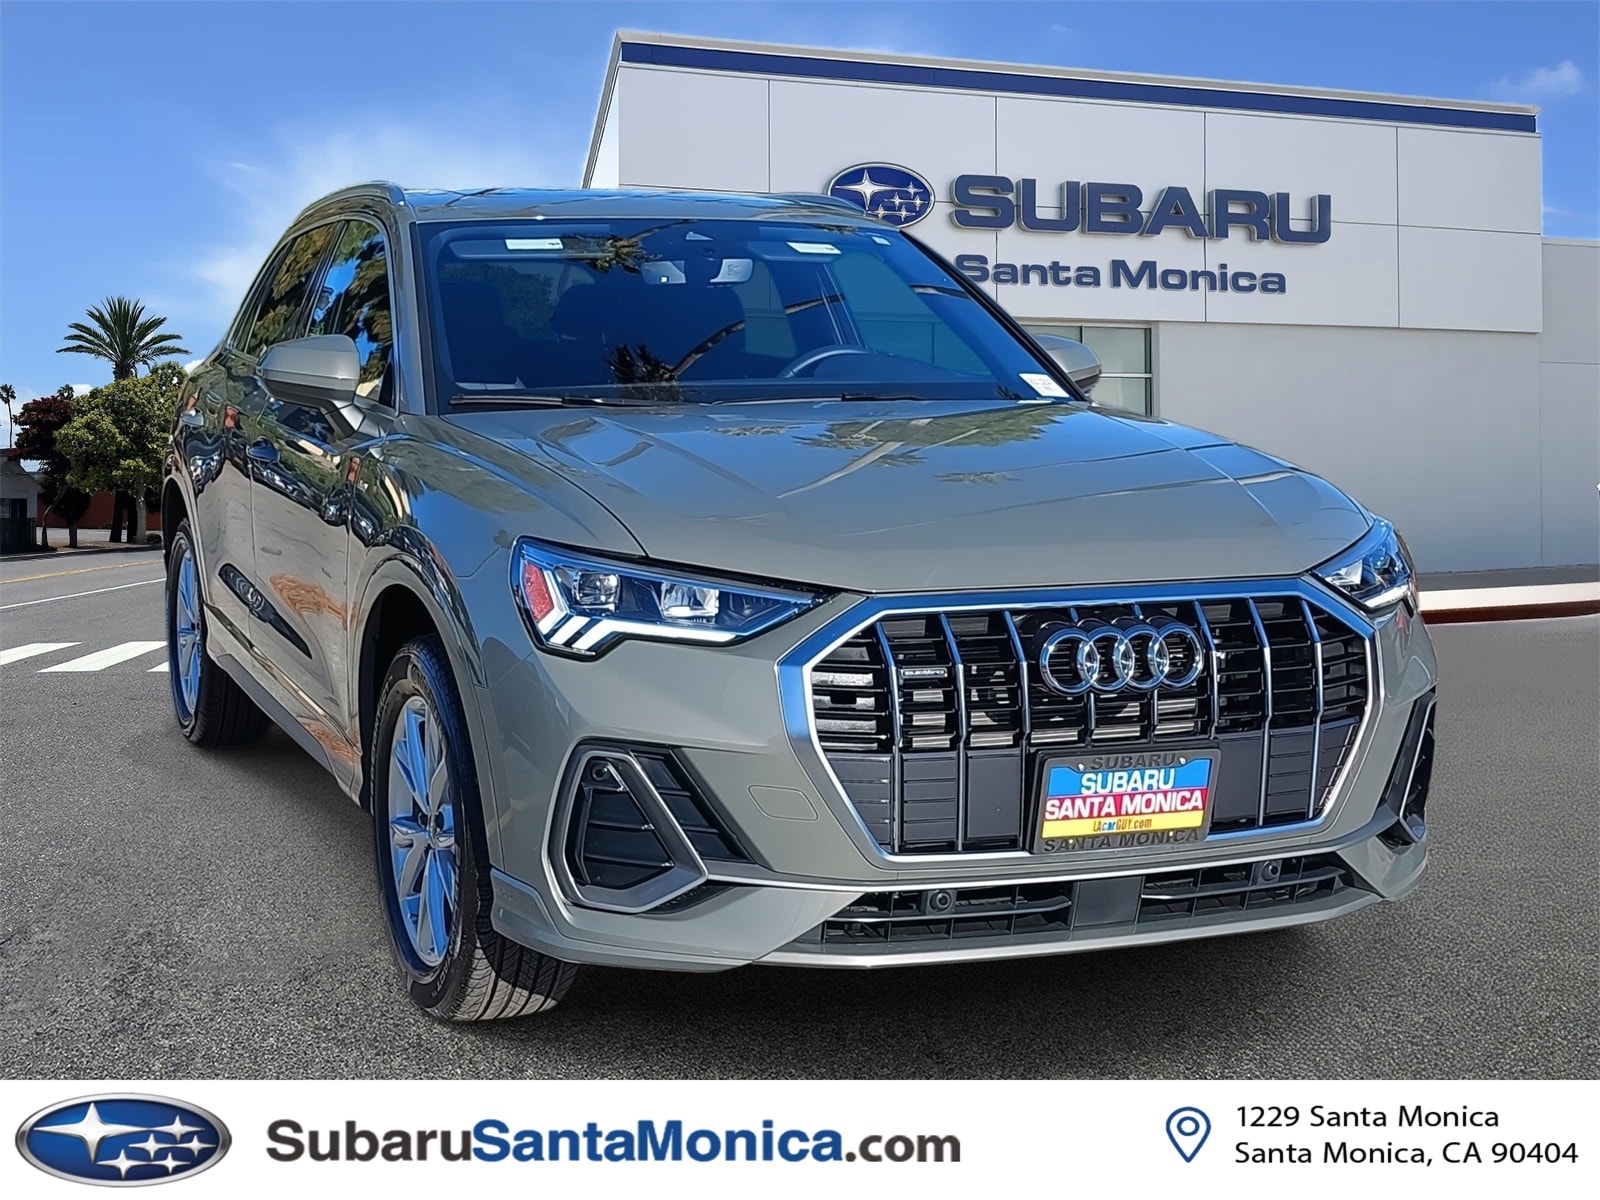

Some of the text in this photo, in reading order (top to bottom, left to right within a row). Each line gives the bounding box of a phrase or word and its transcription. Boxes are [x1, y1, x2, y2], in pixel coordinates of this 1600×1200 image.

[950, 174, 1331, 244] SUBARU
[955, 253, 1287, 294] Santa Monica
[1091, 753, 1176, 770] SUBARU
[1081, 769, 1175, 795] SUBARU
[1045, 790, 1203, 820] SANTA MONICA
[1093, 818, 1153, 832] LAcarGUY.com
[1044, 829, 1199, 852] SANTA MONICA
